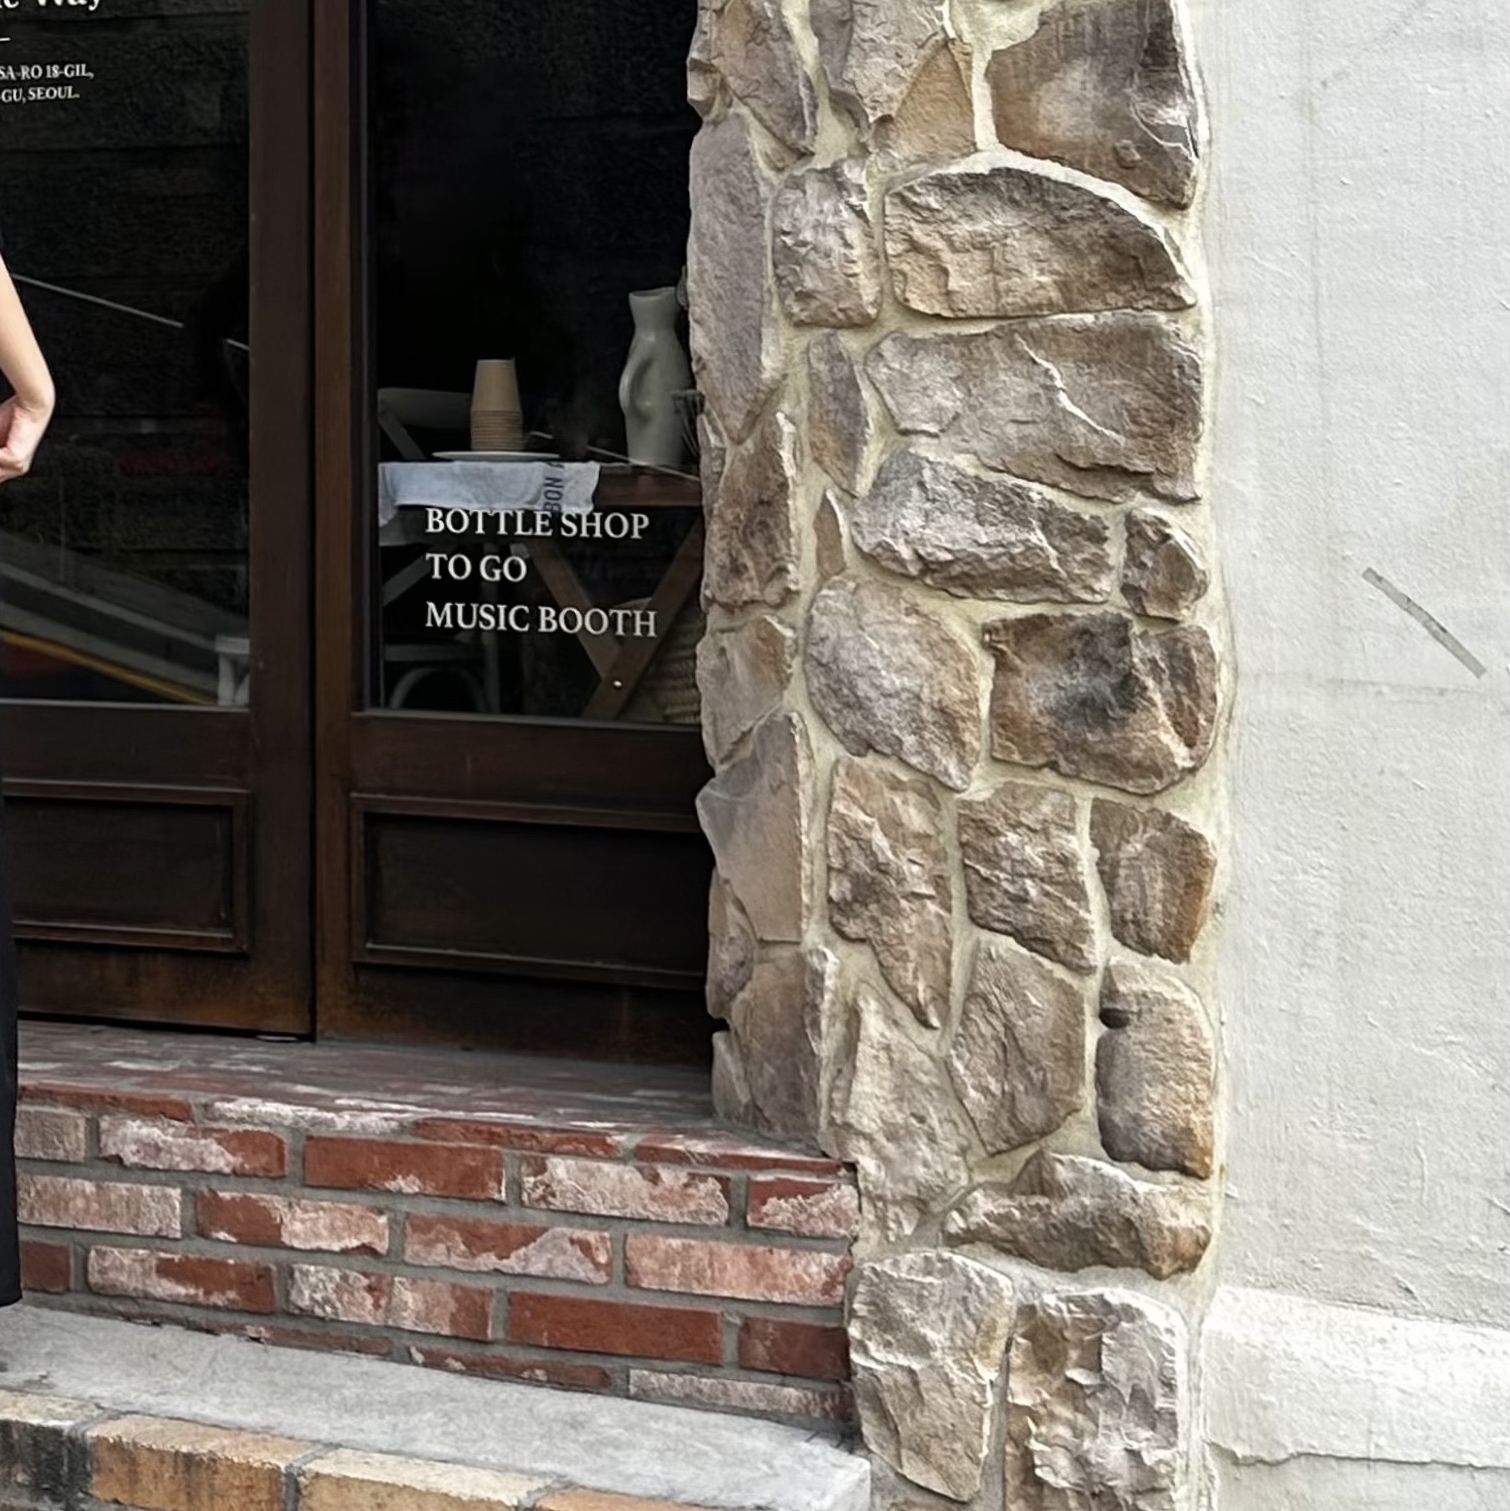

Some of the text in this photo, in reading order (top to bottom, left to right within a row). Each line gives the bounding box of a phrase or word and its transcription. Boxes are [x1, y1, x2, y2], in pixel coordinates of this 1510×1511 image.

[46, 62, 95, 80] 18-GIL,
[424, 507, 650, 540] BOTTLE SHOP
[424, 552, 528, 583] TO GO
[424, 601, 658, 638] MUSIC BOOTH
